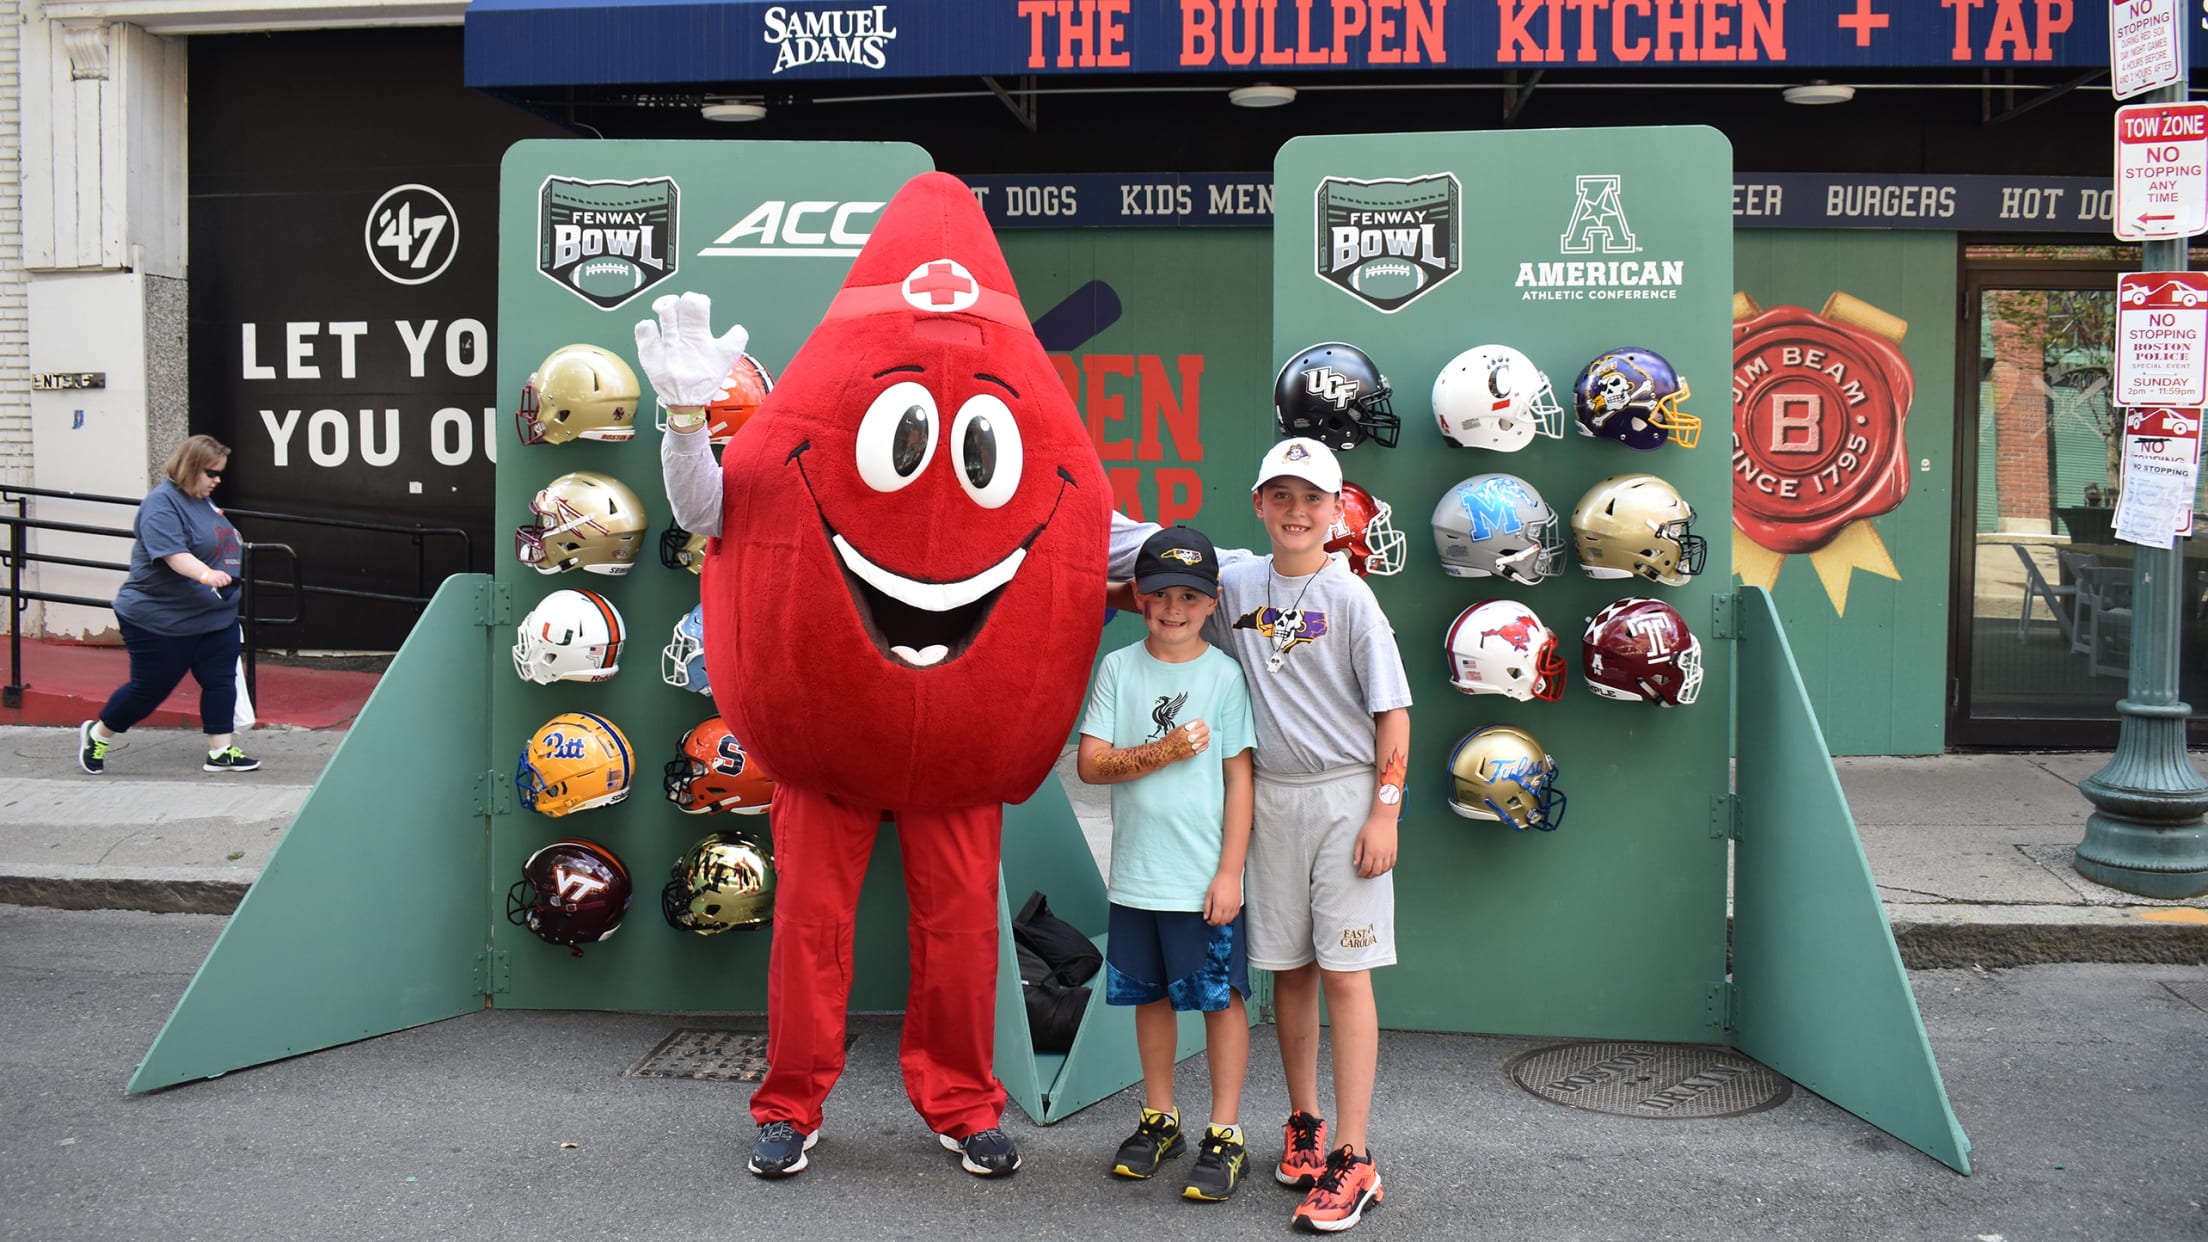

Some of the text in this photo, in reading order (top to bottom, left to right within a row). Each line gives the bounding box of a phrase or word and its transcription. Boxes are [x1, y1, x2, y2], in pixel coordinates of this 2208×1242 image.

[2130, 0, 2152, 19] NO
[764, 5, 897, 43] SAMUEL
[1018, 0, 1131, 68] THE
[1180, 0, 1446, 66] BULLPEN
[1497, 0, 1786, 62] KITCHEN
[1941, 0, 2074, 61] TAP
[2117, 12, 2170, 38] STOPPING
[2121, 26, 2165, 48] DURING RED SOX
[772, 36, 888, 74] ADAMS
[2147, 37, 2168, 51] GAMES
[2127, 57, 2144, 69] HOURS
[2145, 49, 2167, 63] BEFORE
[2135, 66, 2152, 78] HOURS
[2154, 60, 2172, 74] AFTER
[2125, 114, 2204, 138] TOW ZONE
[2146, 146, 2180, 163] NO
[2125, 165, 2202, 179] STOPPING
[2148, 192, 2179, 203] TIME
[2149, 181, 2177, 191] ANY
[1006, 186, 1077, 216] DOGS
[1120, 185, 1193, 215] KIDS
[1826, 185, 1956, 217] BURGERS
[2000, 187, 2064, 219] HOT
[572, 211, 647, 225] FENWAY
[713, 200, 887, 245] ACC
[1350, 210, 1428, 226] FENWAY
[552, 224, 664, 272] BOWL
[1331, 223, 1446, 273] BOWL
[1514, 261, 1684, 287] AMERICAN
[1522, 290, 1677, 300] ATHLETIC CONFERENCE
[2149, 313, 2176, 326] NO
[2129, 329, 2196, 340] STOPPING
[2133, 343, 2192, 351] BOSTON
[242, 318, 488, 379] LET YO
[2136, 352, 2189, 360] POLICE
[1301, 366, 1360, 412] UCF
[1782, 347, 1867, 406] BEAM
[2133, 378, 2189, 387] SUNDAY
[1770, 394, 1821, 452] B
[259, 408, 399, 467] YOU
[1813, 434, 1868, 494] 1795
[2144, 465, 2189, 477] STOPPING
[542, 731, 586, 759] Pitt
[713, 733, 747, 777] S
[554, 866, 608, 903] VT
[1343, 928, 1367, 938] EAST
[1548, 1050, 1660, 1094] BOSTON
[1638, 1063, 1748, 1111] DRAIN
